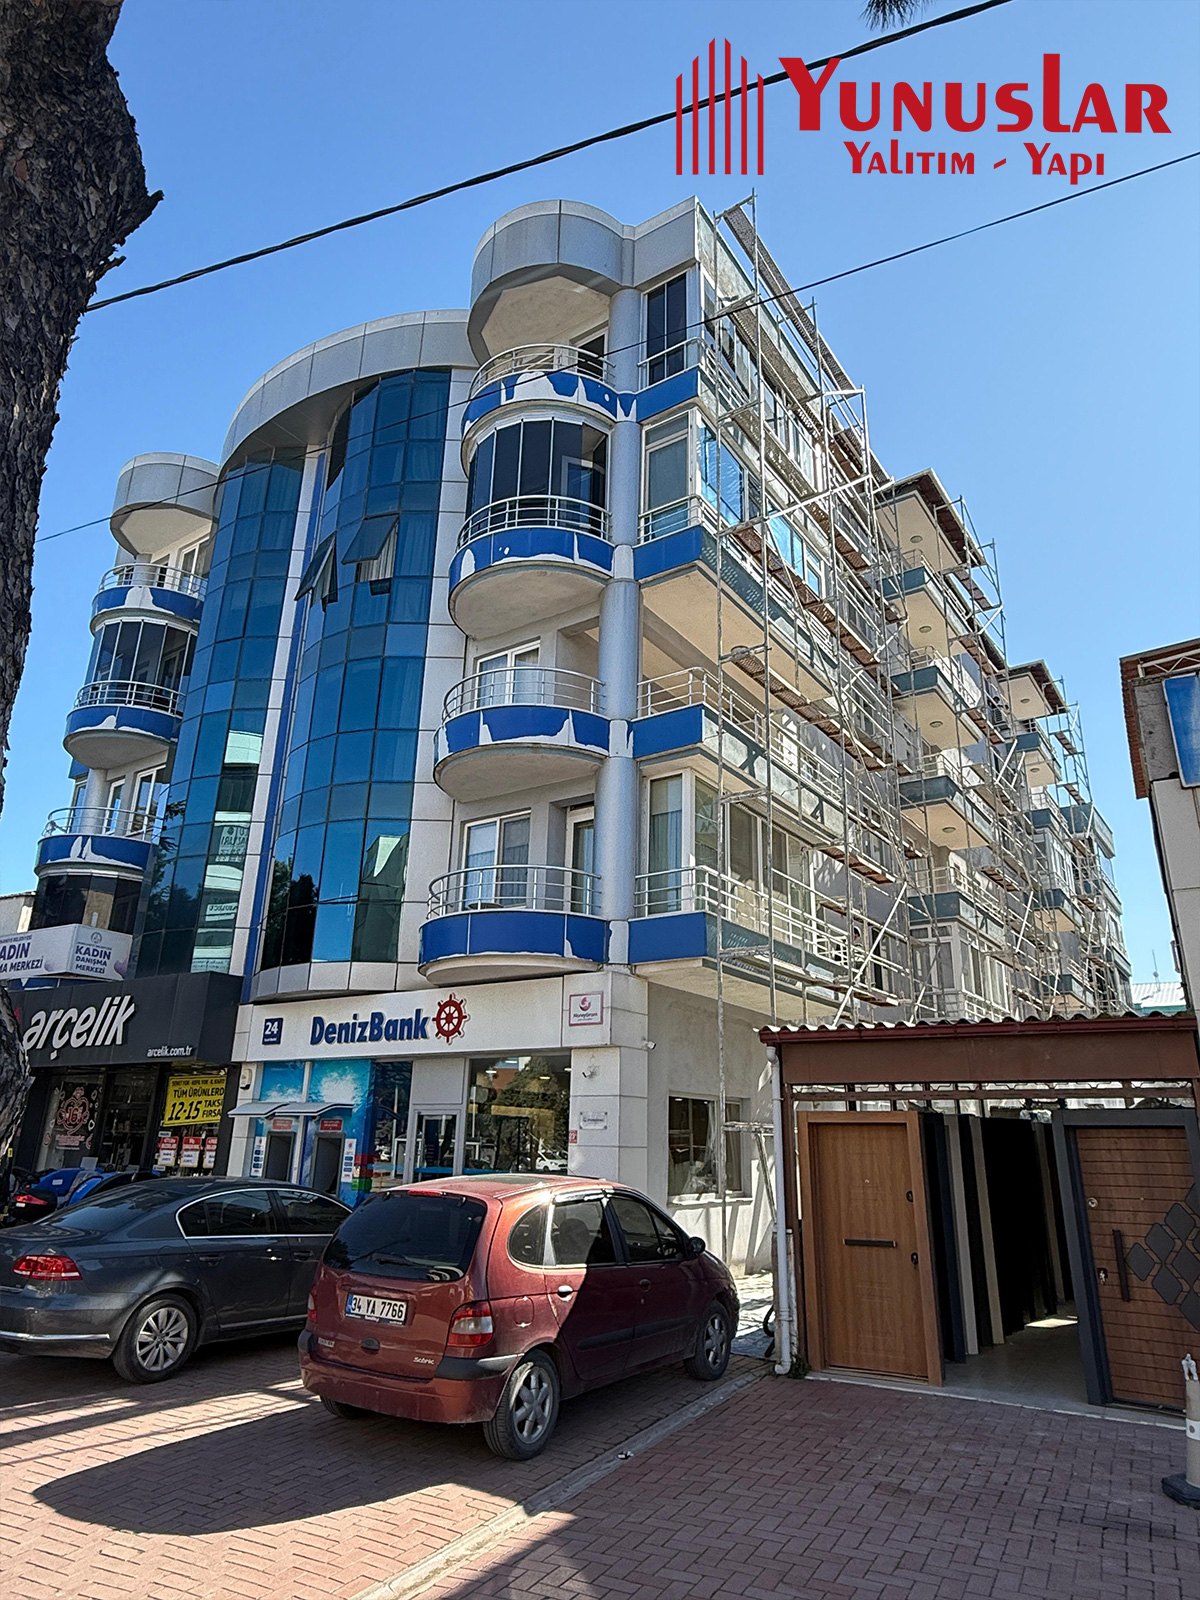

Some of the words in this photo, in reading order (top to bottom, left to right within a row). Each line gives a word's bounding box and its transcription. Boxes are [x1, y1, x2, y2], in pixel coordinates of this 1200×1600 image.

[75, 945, 112, 960] KADIN
[9, 956, 44, 972] MERKEZİ
[75, 955, 107, 967] DANIŞMA
[75, 963, 106, 974] MERKEZİ
[22, 995, 136, 1061] arçelik
[264, 1021, 279, 1035] 24
[309, 1008, 430, 1046] DenizBank
[147, 1045, 193, 1057] arcelik.com.tr
[173, 1087, 188, 1098] TÜM
[351, 1297, 362, 1312] 34
[365, 1299, 376, 1315] YA
[380, 1301, 405, 1319] 7766
